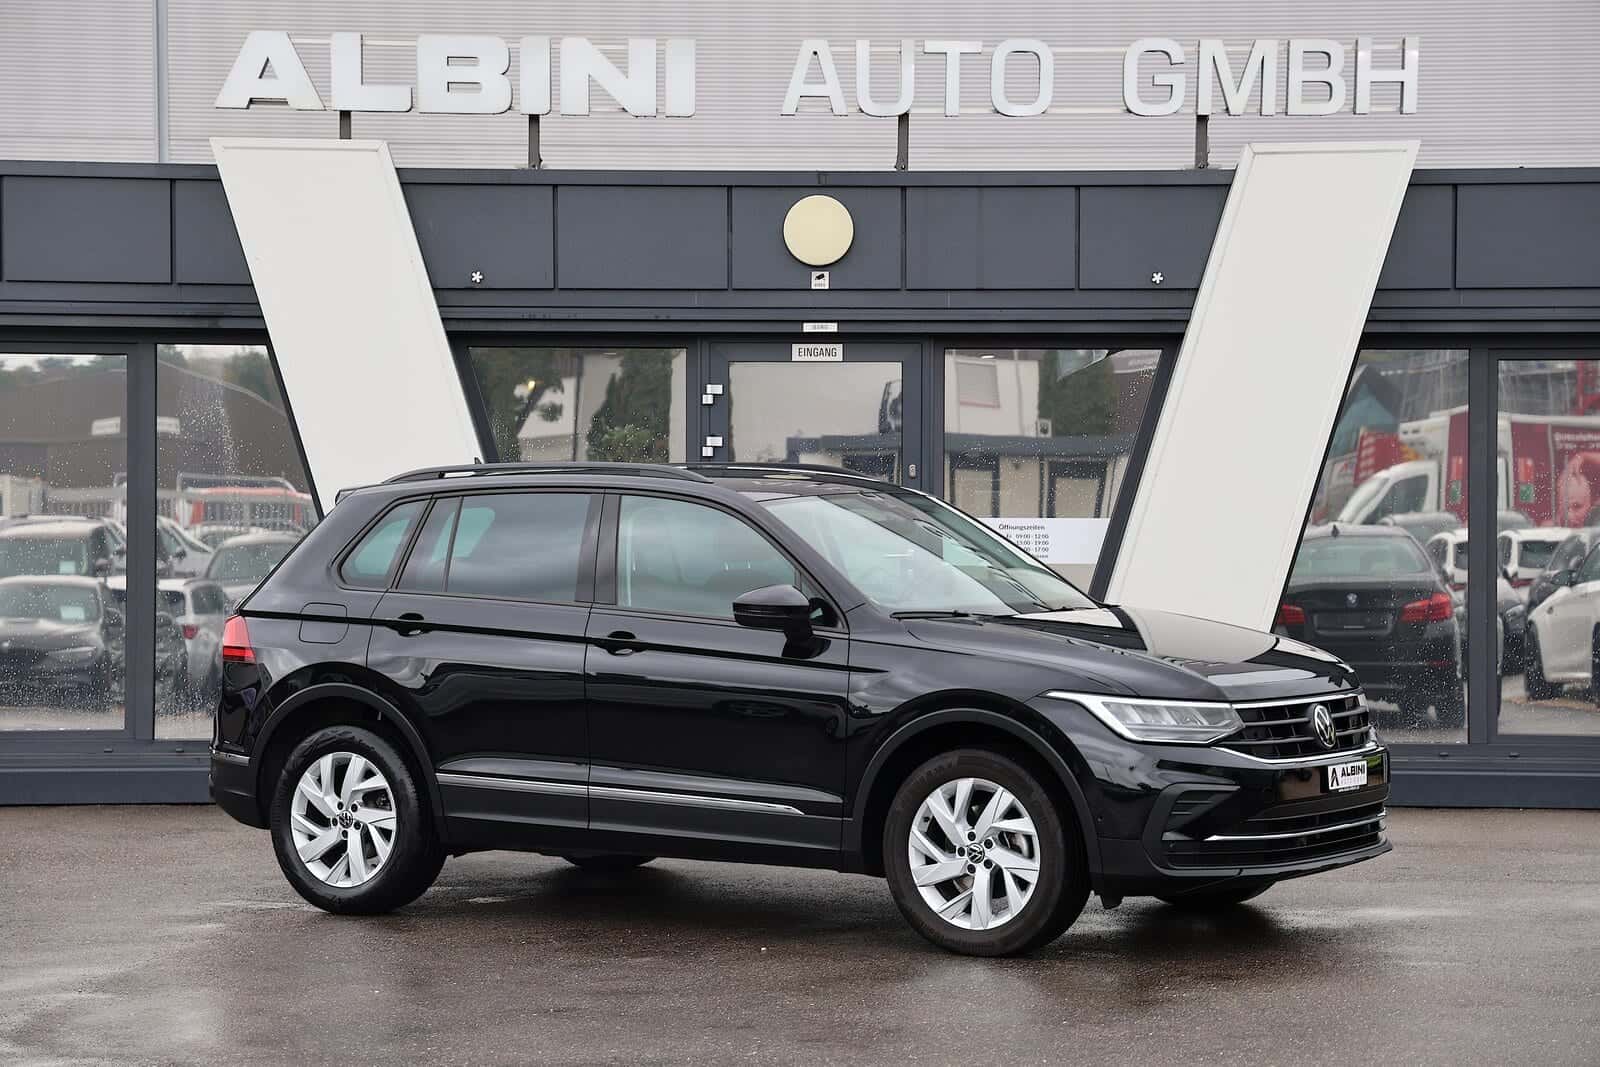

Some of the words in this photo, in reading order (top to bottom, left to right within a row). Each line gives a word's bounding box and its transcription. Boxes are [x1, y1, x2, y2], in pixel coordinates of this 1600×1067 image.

[215, 31, 696, 117] ALBINI
[780, 38, 1054, 117] AUTO
[1122, 36, 1420, 117] GMBH
[798, 347, 837, 357] EINGANG
[1341, 764, 1366, 777] ALBINI
